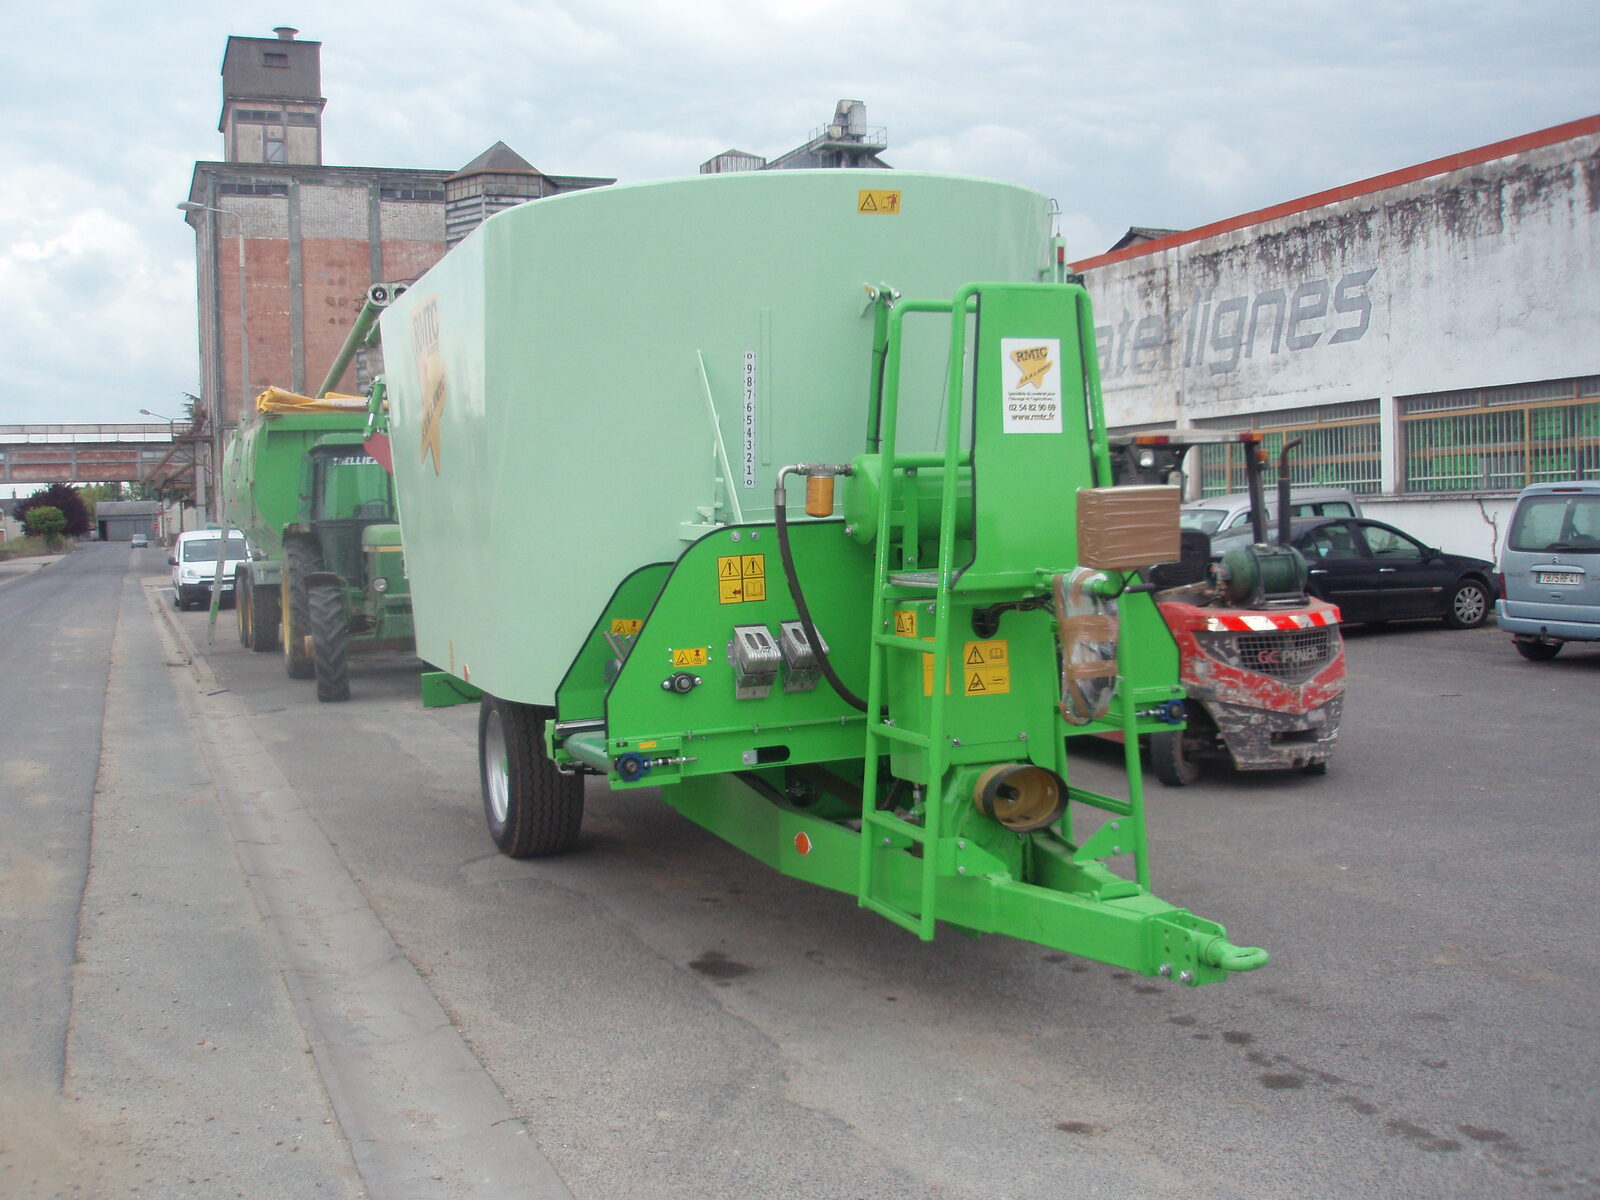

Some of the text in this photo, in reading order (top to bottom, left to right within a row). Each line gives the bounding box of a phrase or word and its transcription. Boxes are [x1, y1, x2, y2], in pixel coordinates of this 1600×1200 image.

[1016, 347, 1048, 362] RMTC
[1008, 404, 1017, 412] 02
[1019, 404, 1027, 412] 54
[1011, 412, 1055, 421] www.rmtc.fr
[1281, 647, 1319, 664] POWER
